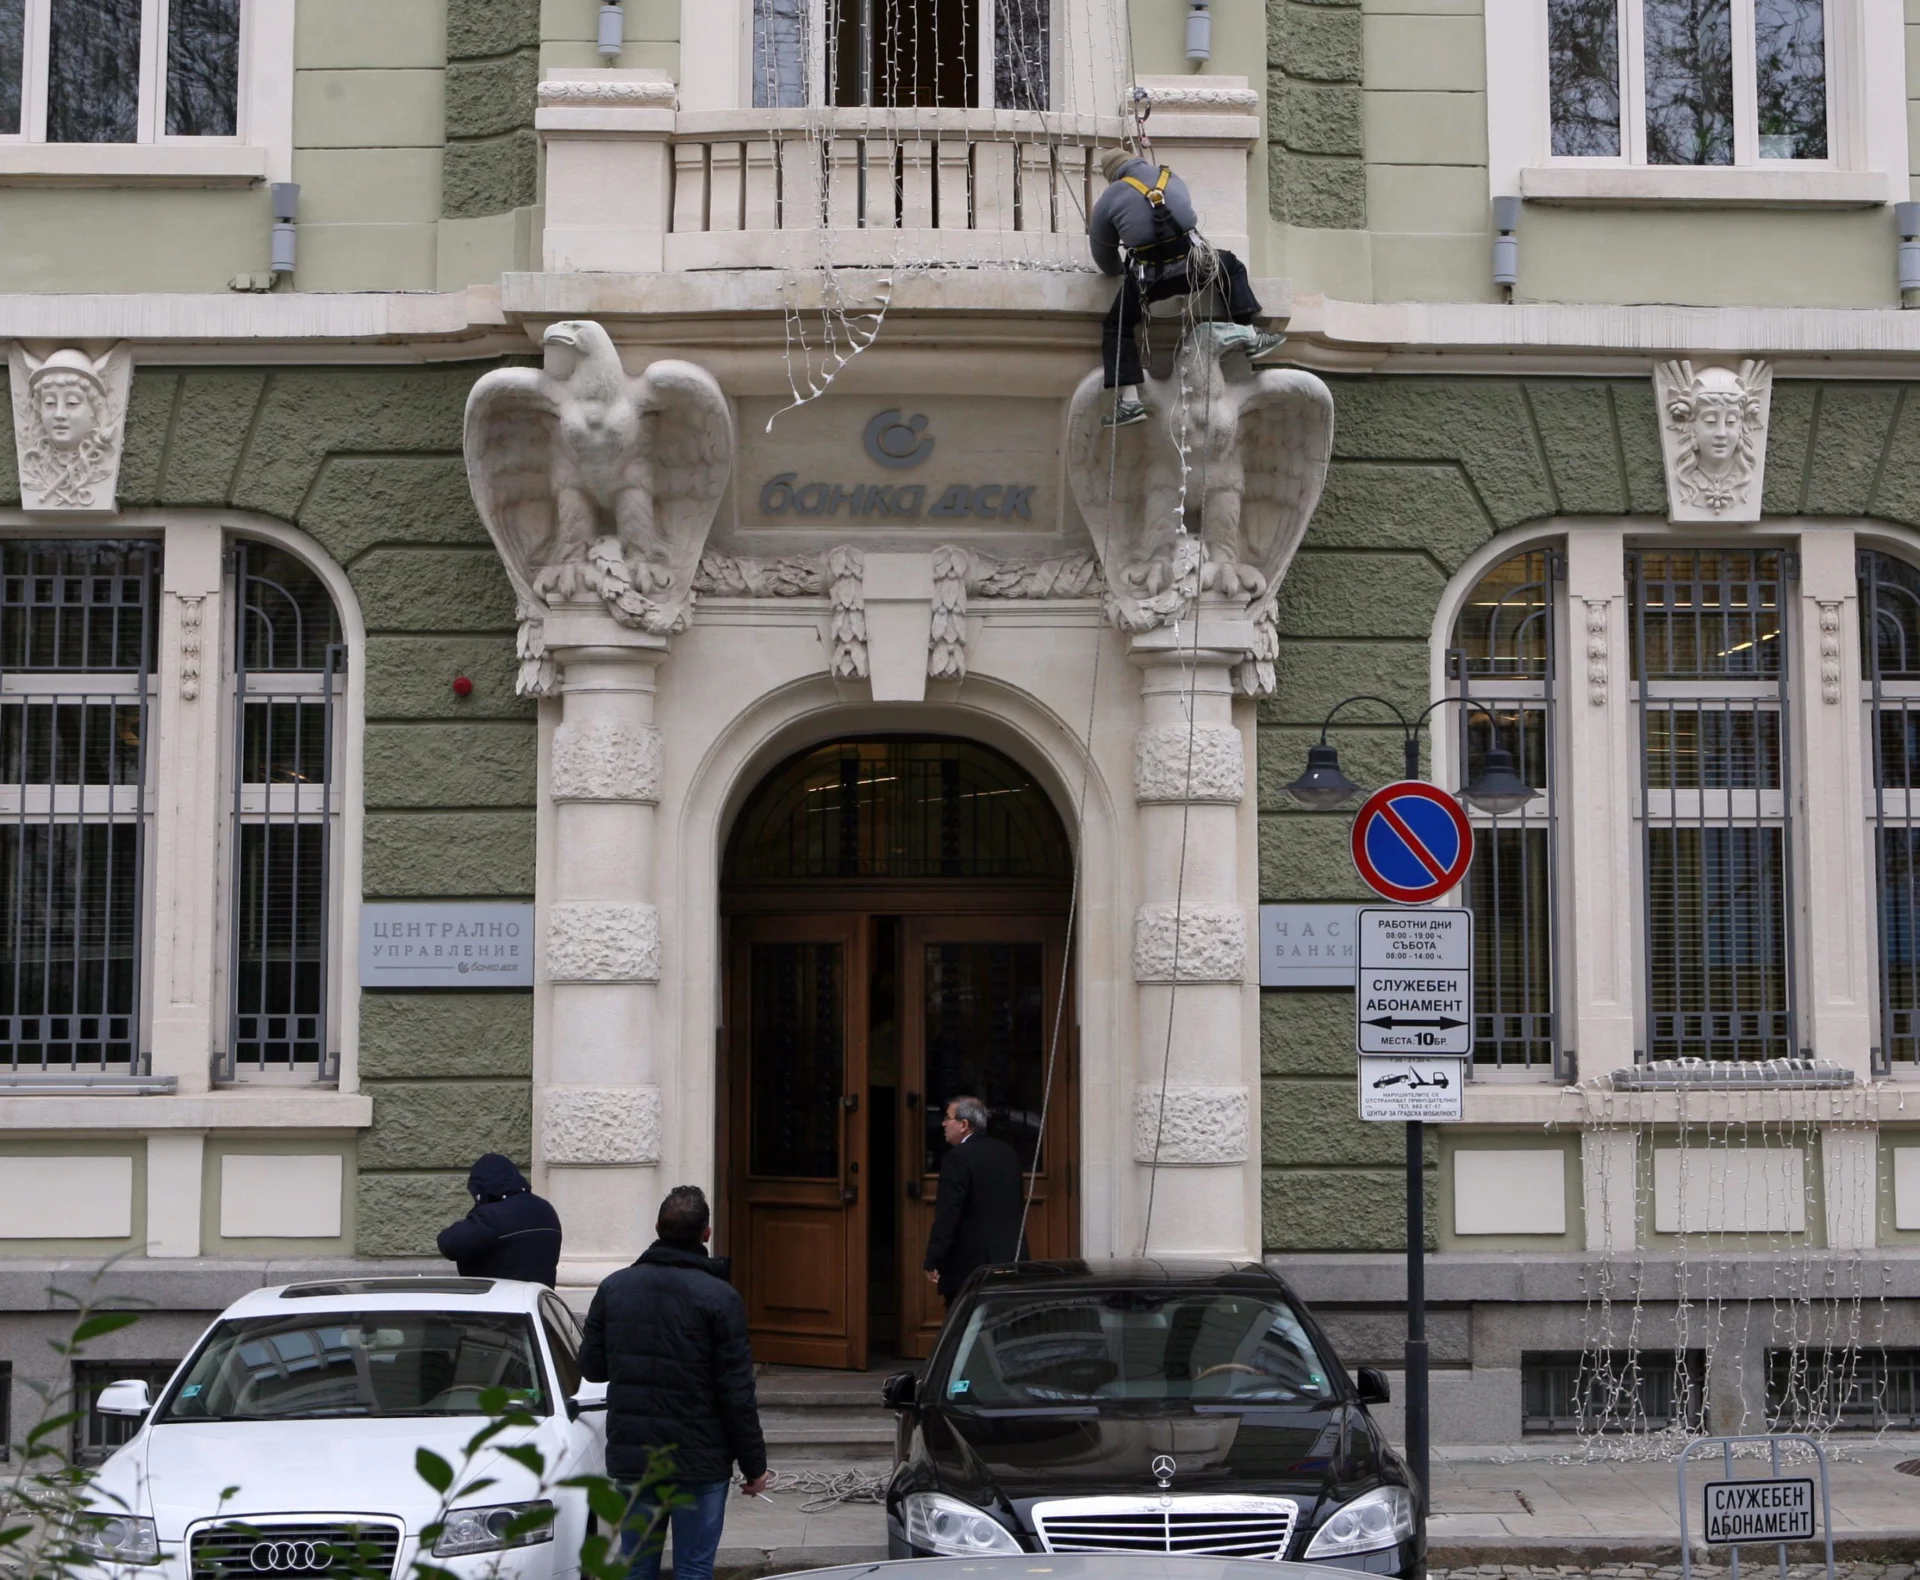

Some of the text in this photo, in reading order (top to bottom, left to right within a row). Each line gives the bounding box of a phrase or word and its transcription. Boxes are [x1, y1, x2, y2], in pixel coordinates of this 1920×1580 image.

[759, 472, 926, 517] банка
[373, 922, 520, 939] ЦЕНТРАЛНО
[1275, 922, 1356, 937] ЧАС
[1378, 920, 1452, 930] РАБОТНИ ДНИ
[373, 945, 520, 956] УПРАВЛЕНИЕ
[1275, 944, 1354, 957] БАНКИ
[1392, 941, 1437, 950] СЪБОТА
[1386, 952, 1407, 960] 08:00
[1373, 979, 1457, 992] СЛУЖЕБЕН
[1366, 999, 1463, 1012] АБОНАМЕНТ
[1414, 1032, 1434, 1046] 10
[1716, 1487, 1803, 1510] СЛУЖЕБЕН
[1711, 1512, 1809, 1536] АБОНАМЕНТ
